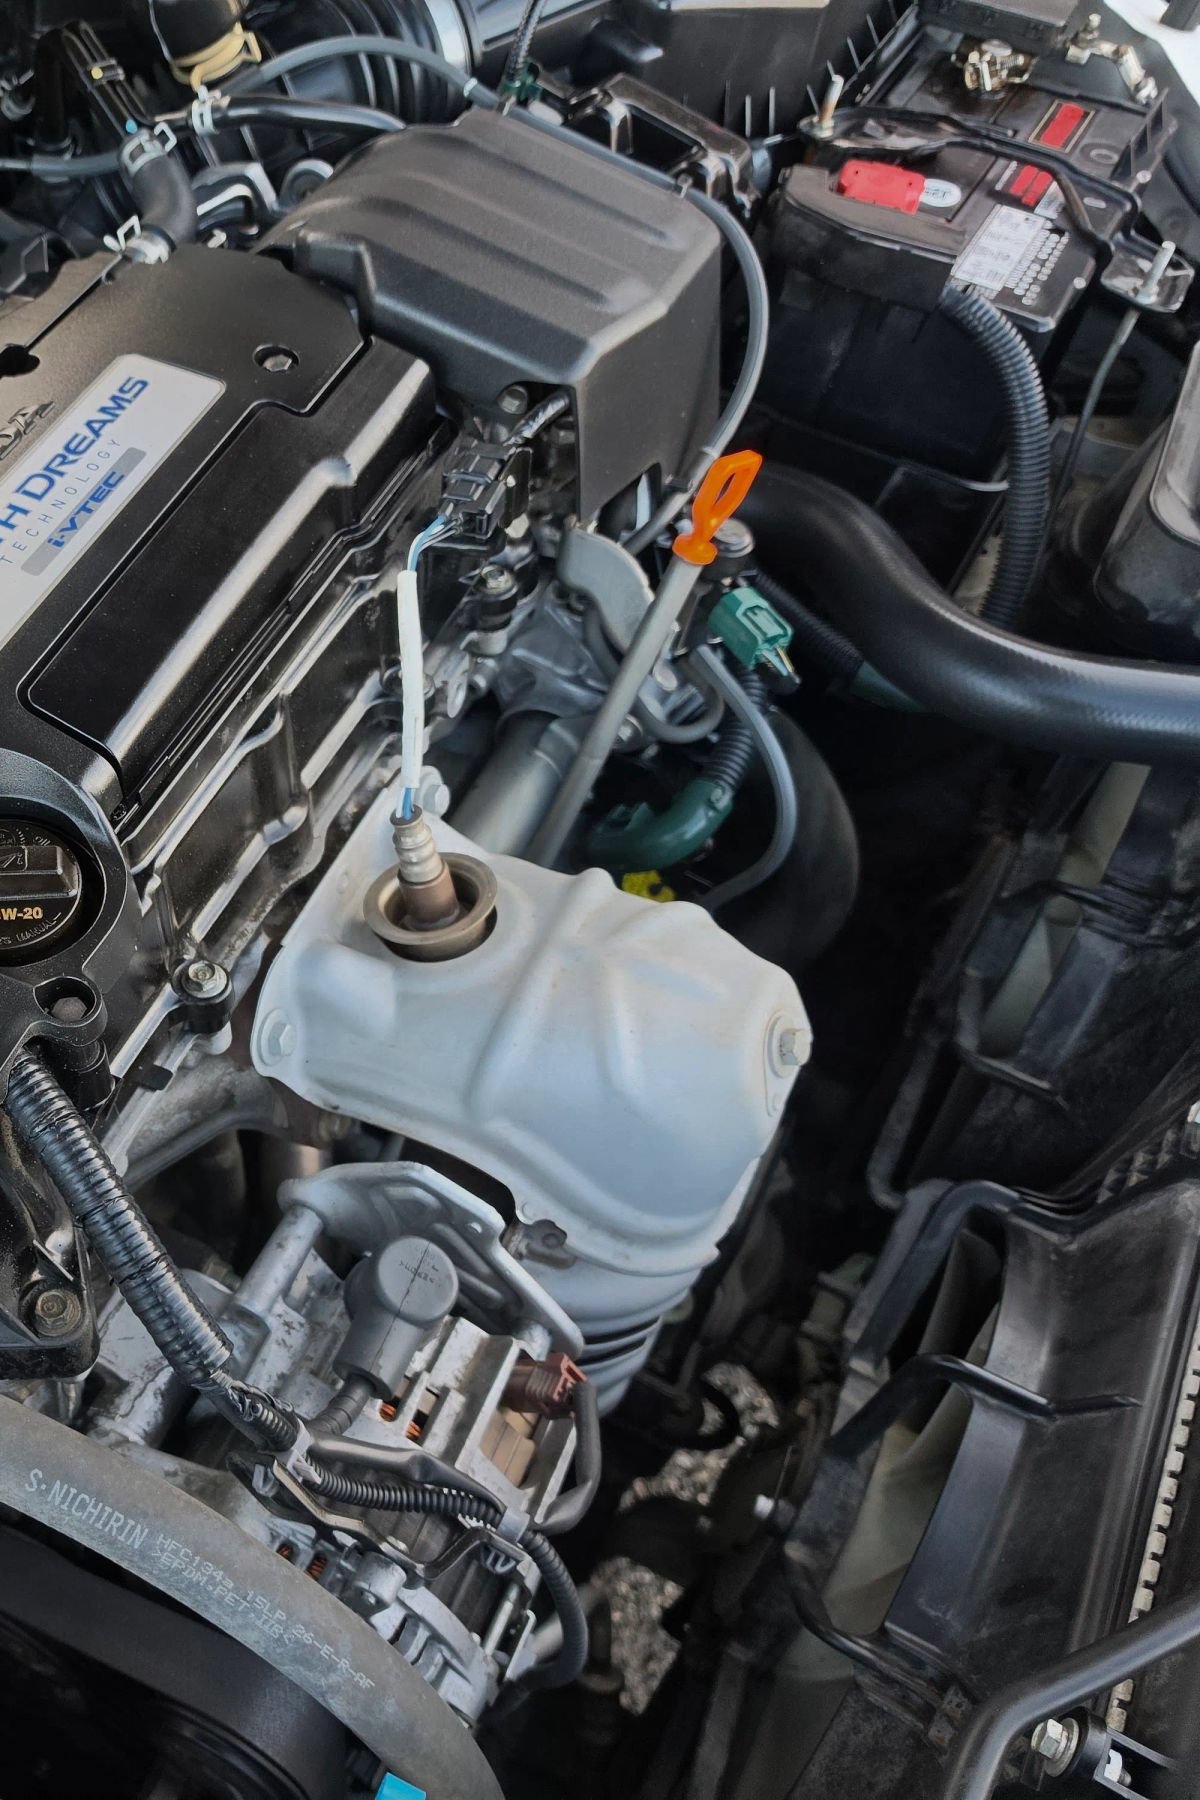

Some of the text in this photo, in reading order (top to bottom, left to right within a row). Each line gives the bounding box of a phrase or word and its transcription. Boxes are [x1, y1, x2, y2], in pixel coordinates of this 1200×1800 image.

[13, 377, 149, 501] DREAMS
[0, 438, 121, 564] TECHNOLOGY
[48, 471, 124, 548] i-VTEC
[157, 1534, 234, 1589] HFC134a
[246, 1590, 287, 1620] 15LP
